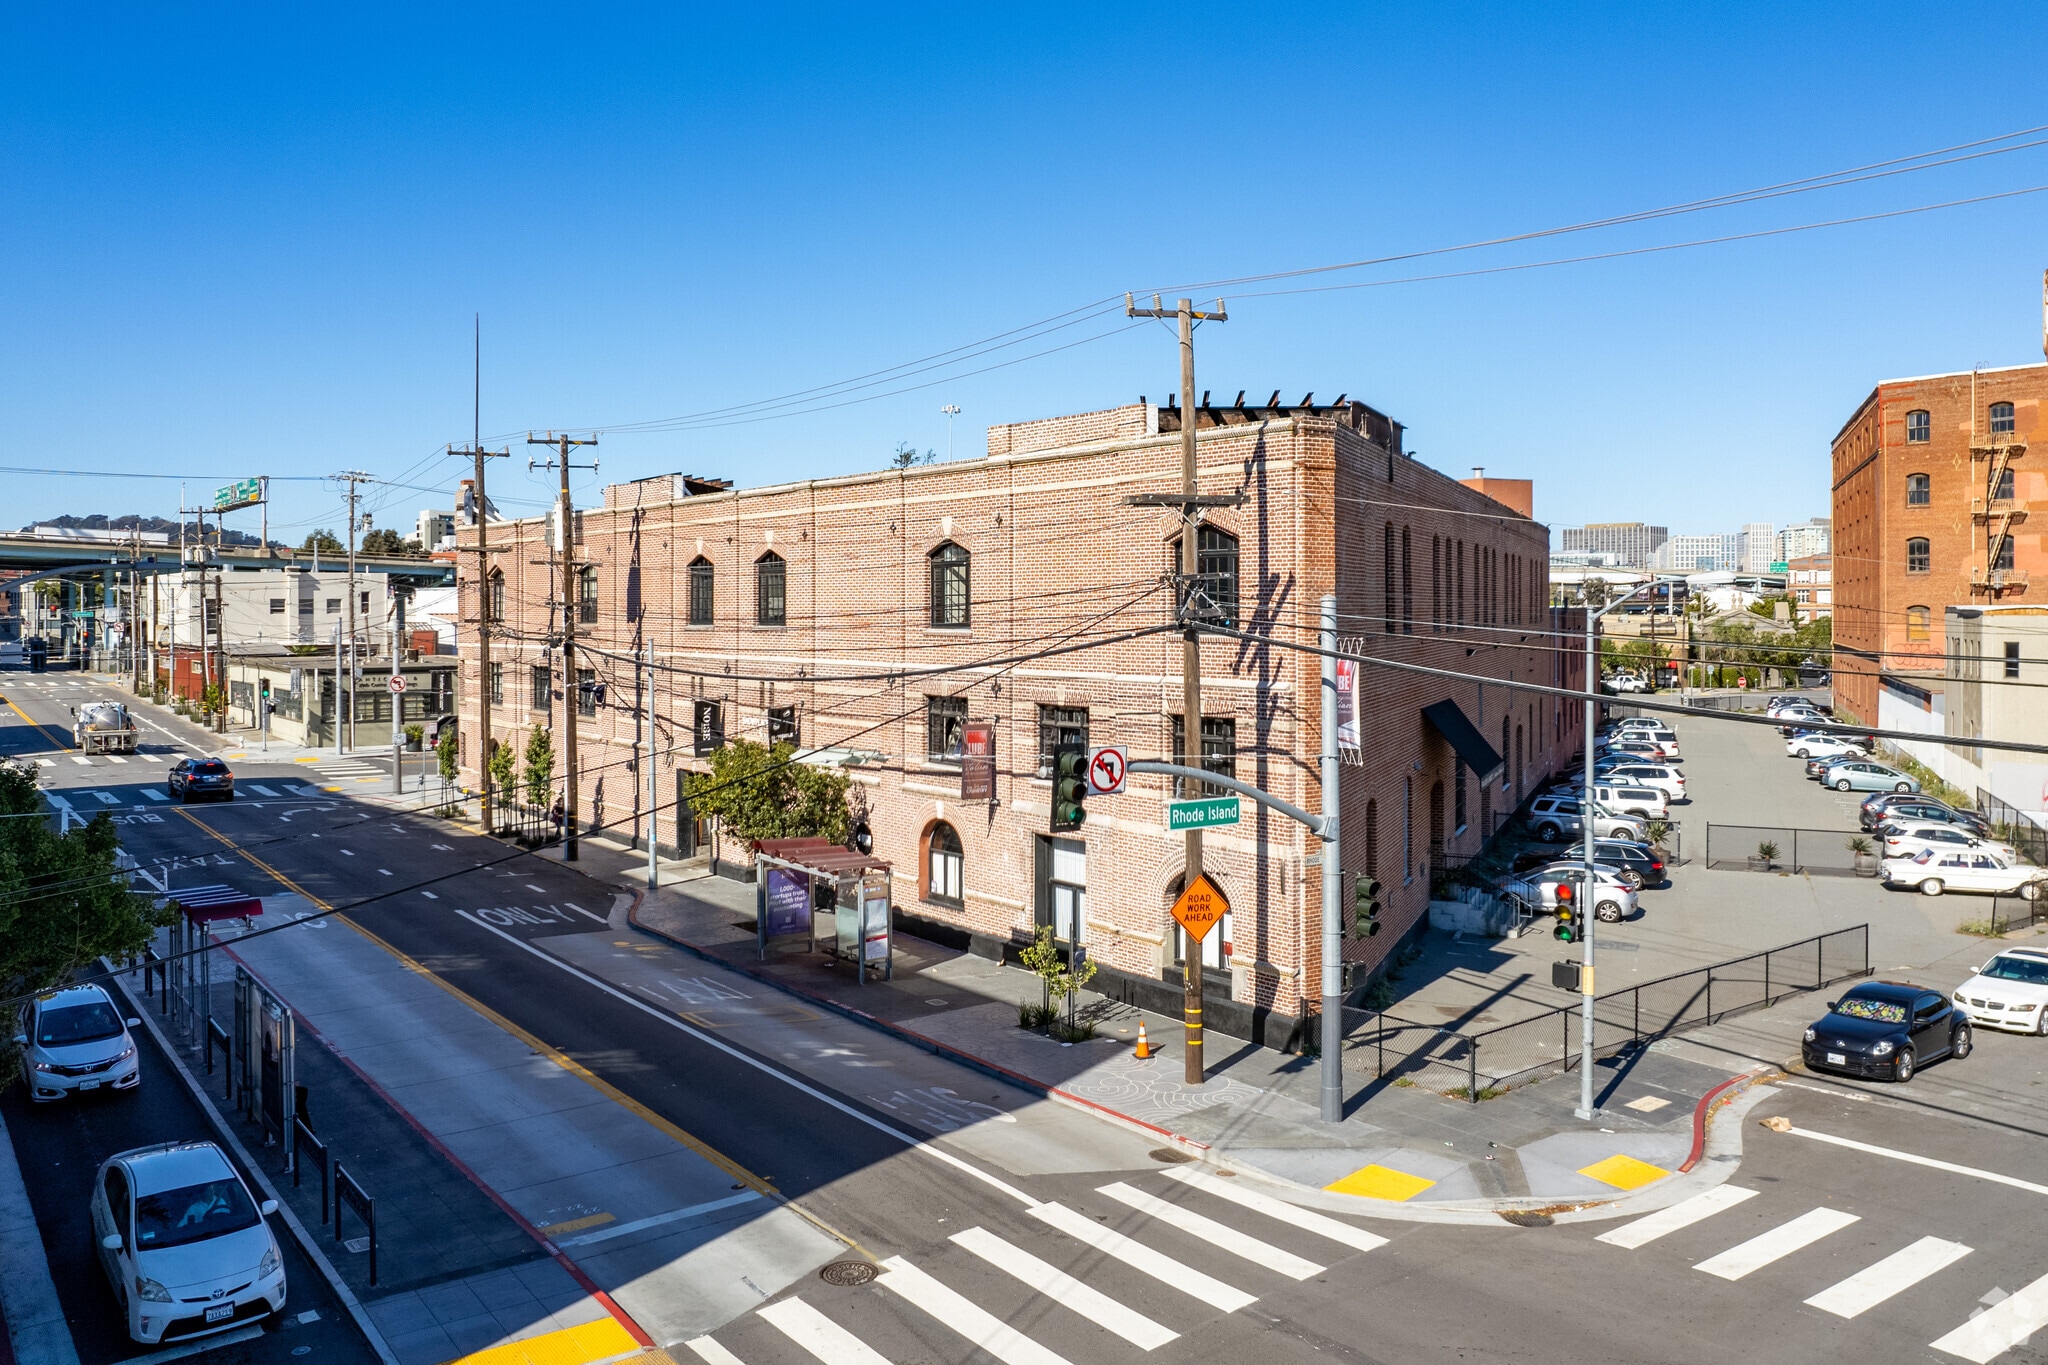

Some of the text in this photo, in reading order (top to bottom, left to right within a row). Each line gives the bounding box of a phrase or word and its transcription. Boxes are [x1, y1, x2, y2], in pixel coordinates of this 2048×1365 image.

[1172, 804, 1237, 824] Rhode Island
[1187, 894, 1212, 903] ROAD
[1187, 903, 1211, 912] WORK
[476, 904, 576, 926] ONLY
[1184, 912, 1214, 922] AHEAD
